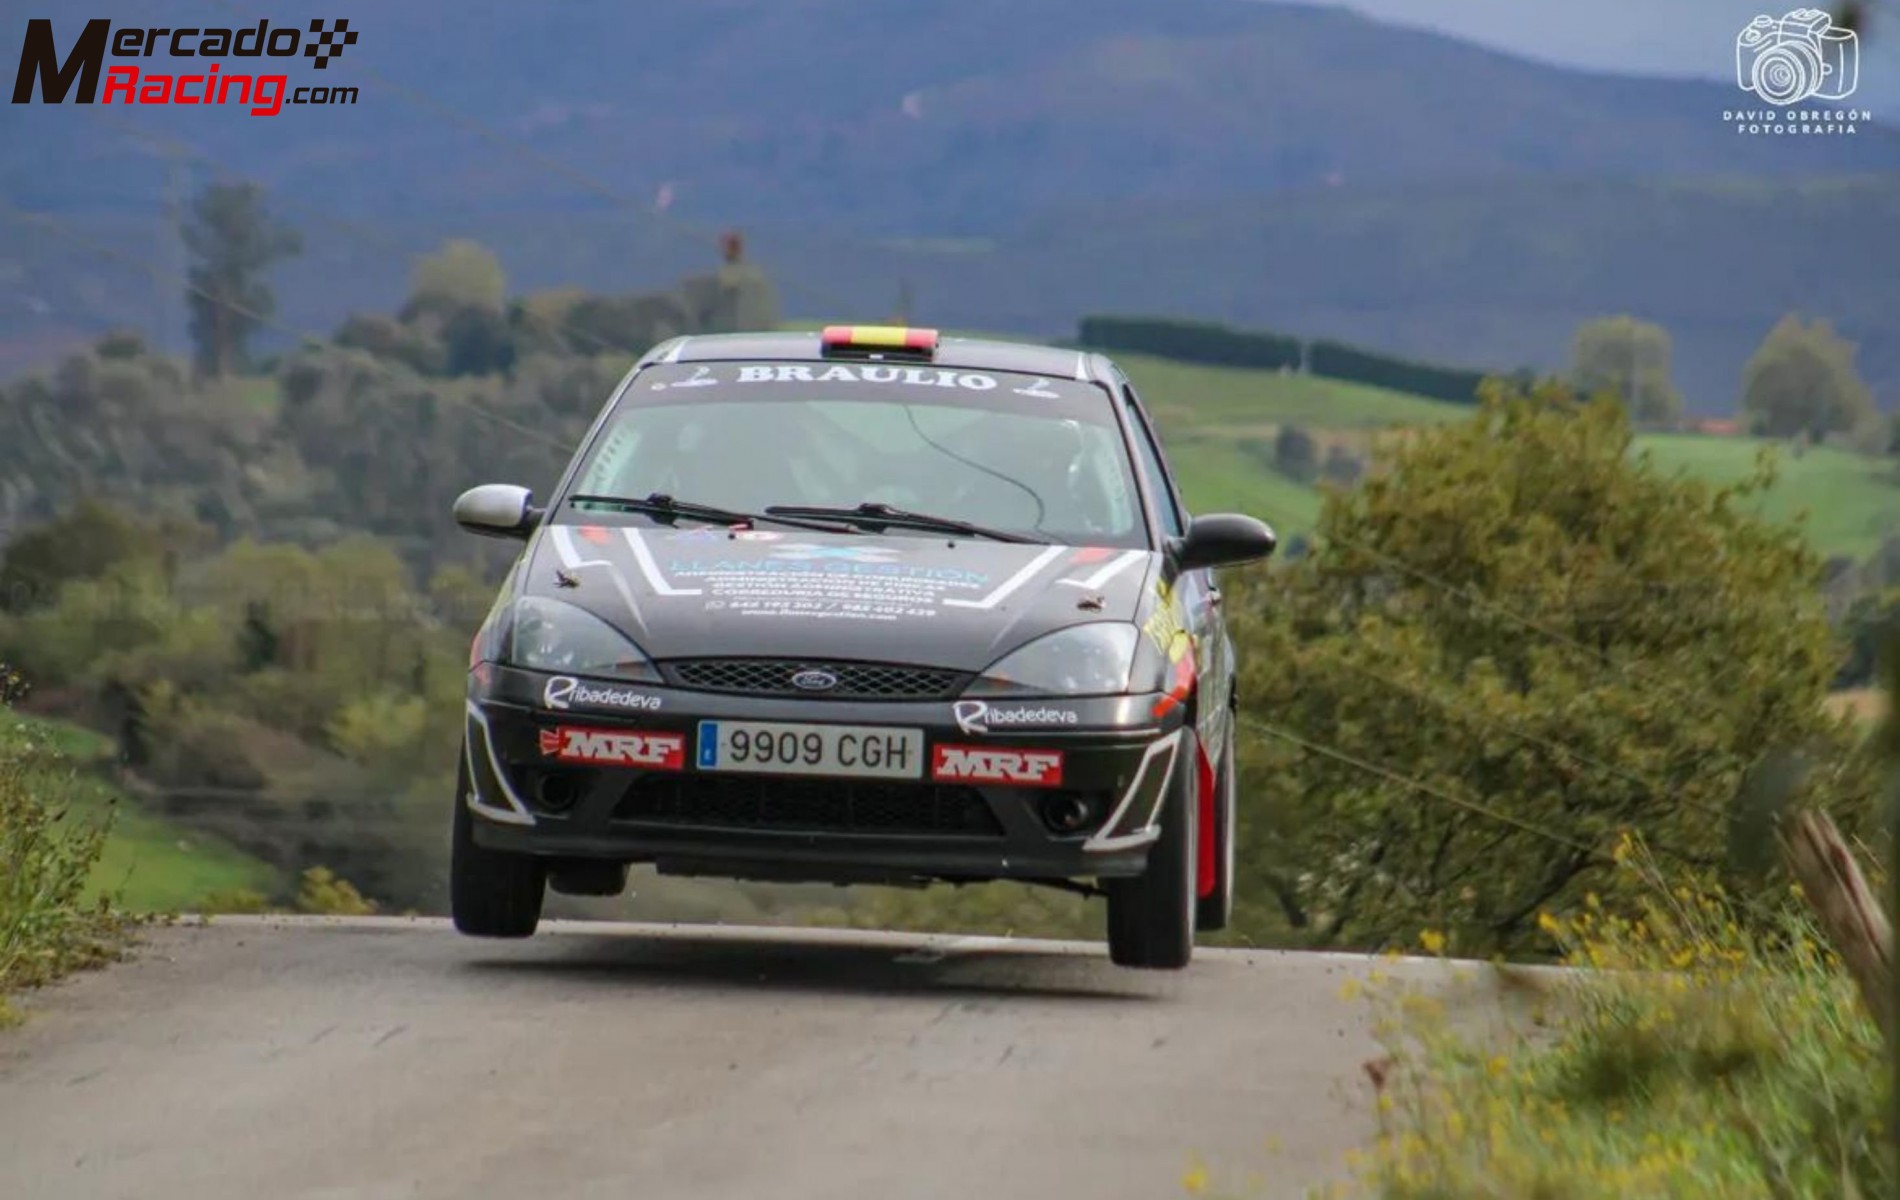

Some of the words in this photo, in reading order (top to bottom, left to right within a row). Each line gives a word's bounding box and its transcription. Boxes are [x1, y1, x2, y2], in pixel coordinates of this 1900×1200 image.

[736, 364, 998, 391] BRAULIO
[560, 730, 681, 763] MRF
[729, 729, 824, 765] 9909
[837, 733, 909, 769] CGH
[936, 748, 1061, 781] MRF
